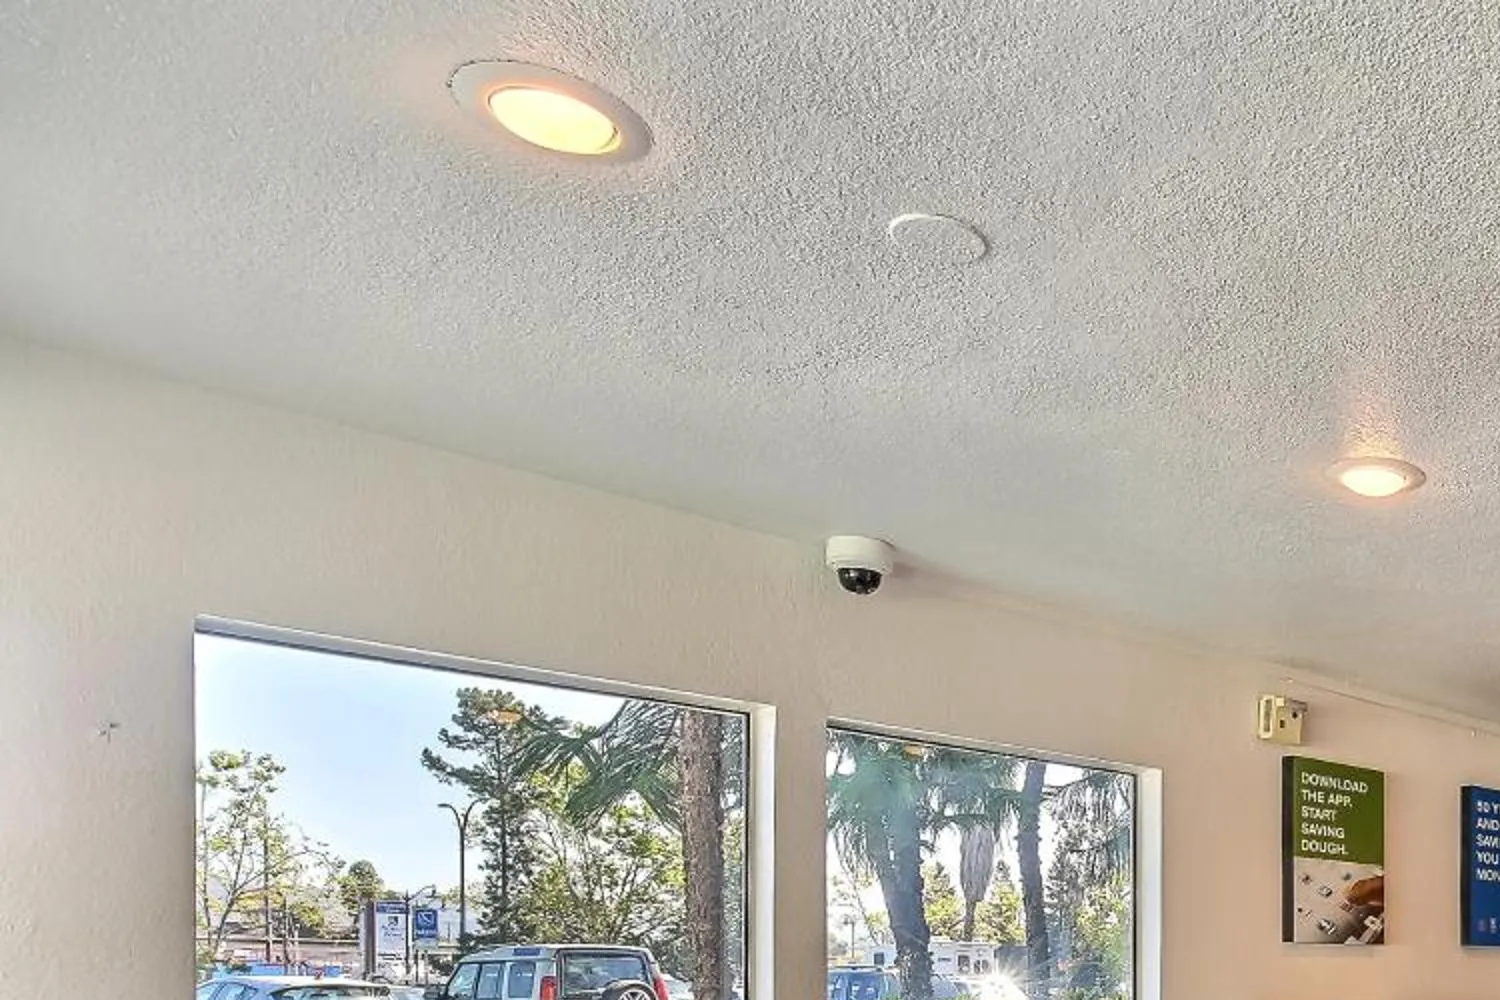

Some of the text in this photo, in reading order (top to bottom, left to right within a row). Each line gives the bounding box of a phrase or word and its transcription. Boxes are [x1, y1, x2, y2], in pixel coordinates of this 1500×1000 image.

[1301, 771, 1369, 793] DOWNLOAD
[1301, 789, 1353, 808] THE APP.
[1301, 805, 1337, 821] START
[1301, 822, 1345, 839] SAVING
[1475, 817, 1500, 831] AND
[1301, 839, 1349, 855] DOUGH.
[1475, 851, 1499, 865] YOU
